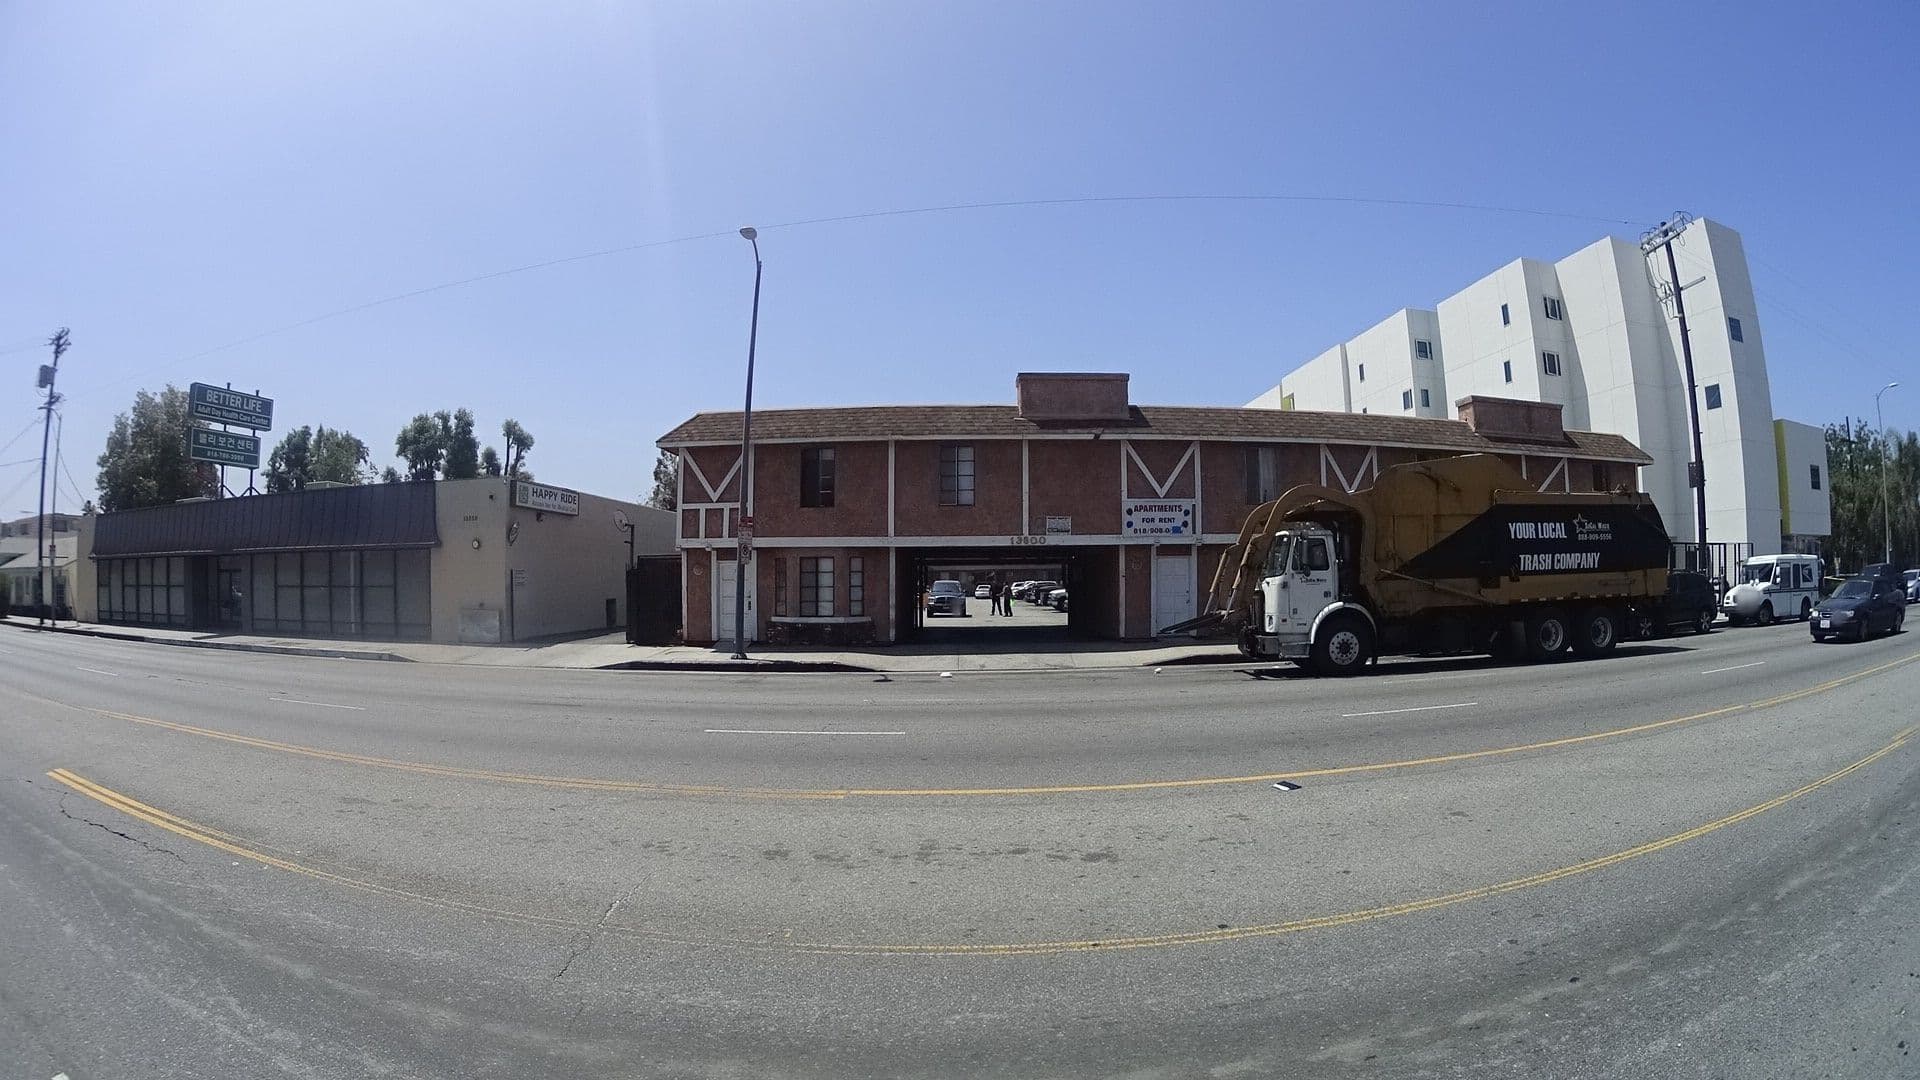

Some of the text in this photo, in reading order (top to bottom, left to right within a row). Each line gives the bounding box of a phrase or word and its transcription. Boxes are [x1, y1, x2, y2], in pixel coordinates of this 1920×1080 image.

[206, 389, 262, 413] BETTER LIFE
[532, 487, 558, 502] HAPPY
[560, 493, 577, 505] RIDE
[1133, 504, 1184, 513] APARTMENTS
[1508, 522, 1567, 540] YOUR LOCAL
[1519, 552, 1600, 571] TRASH COMPANY
